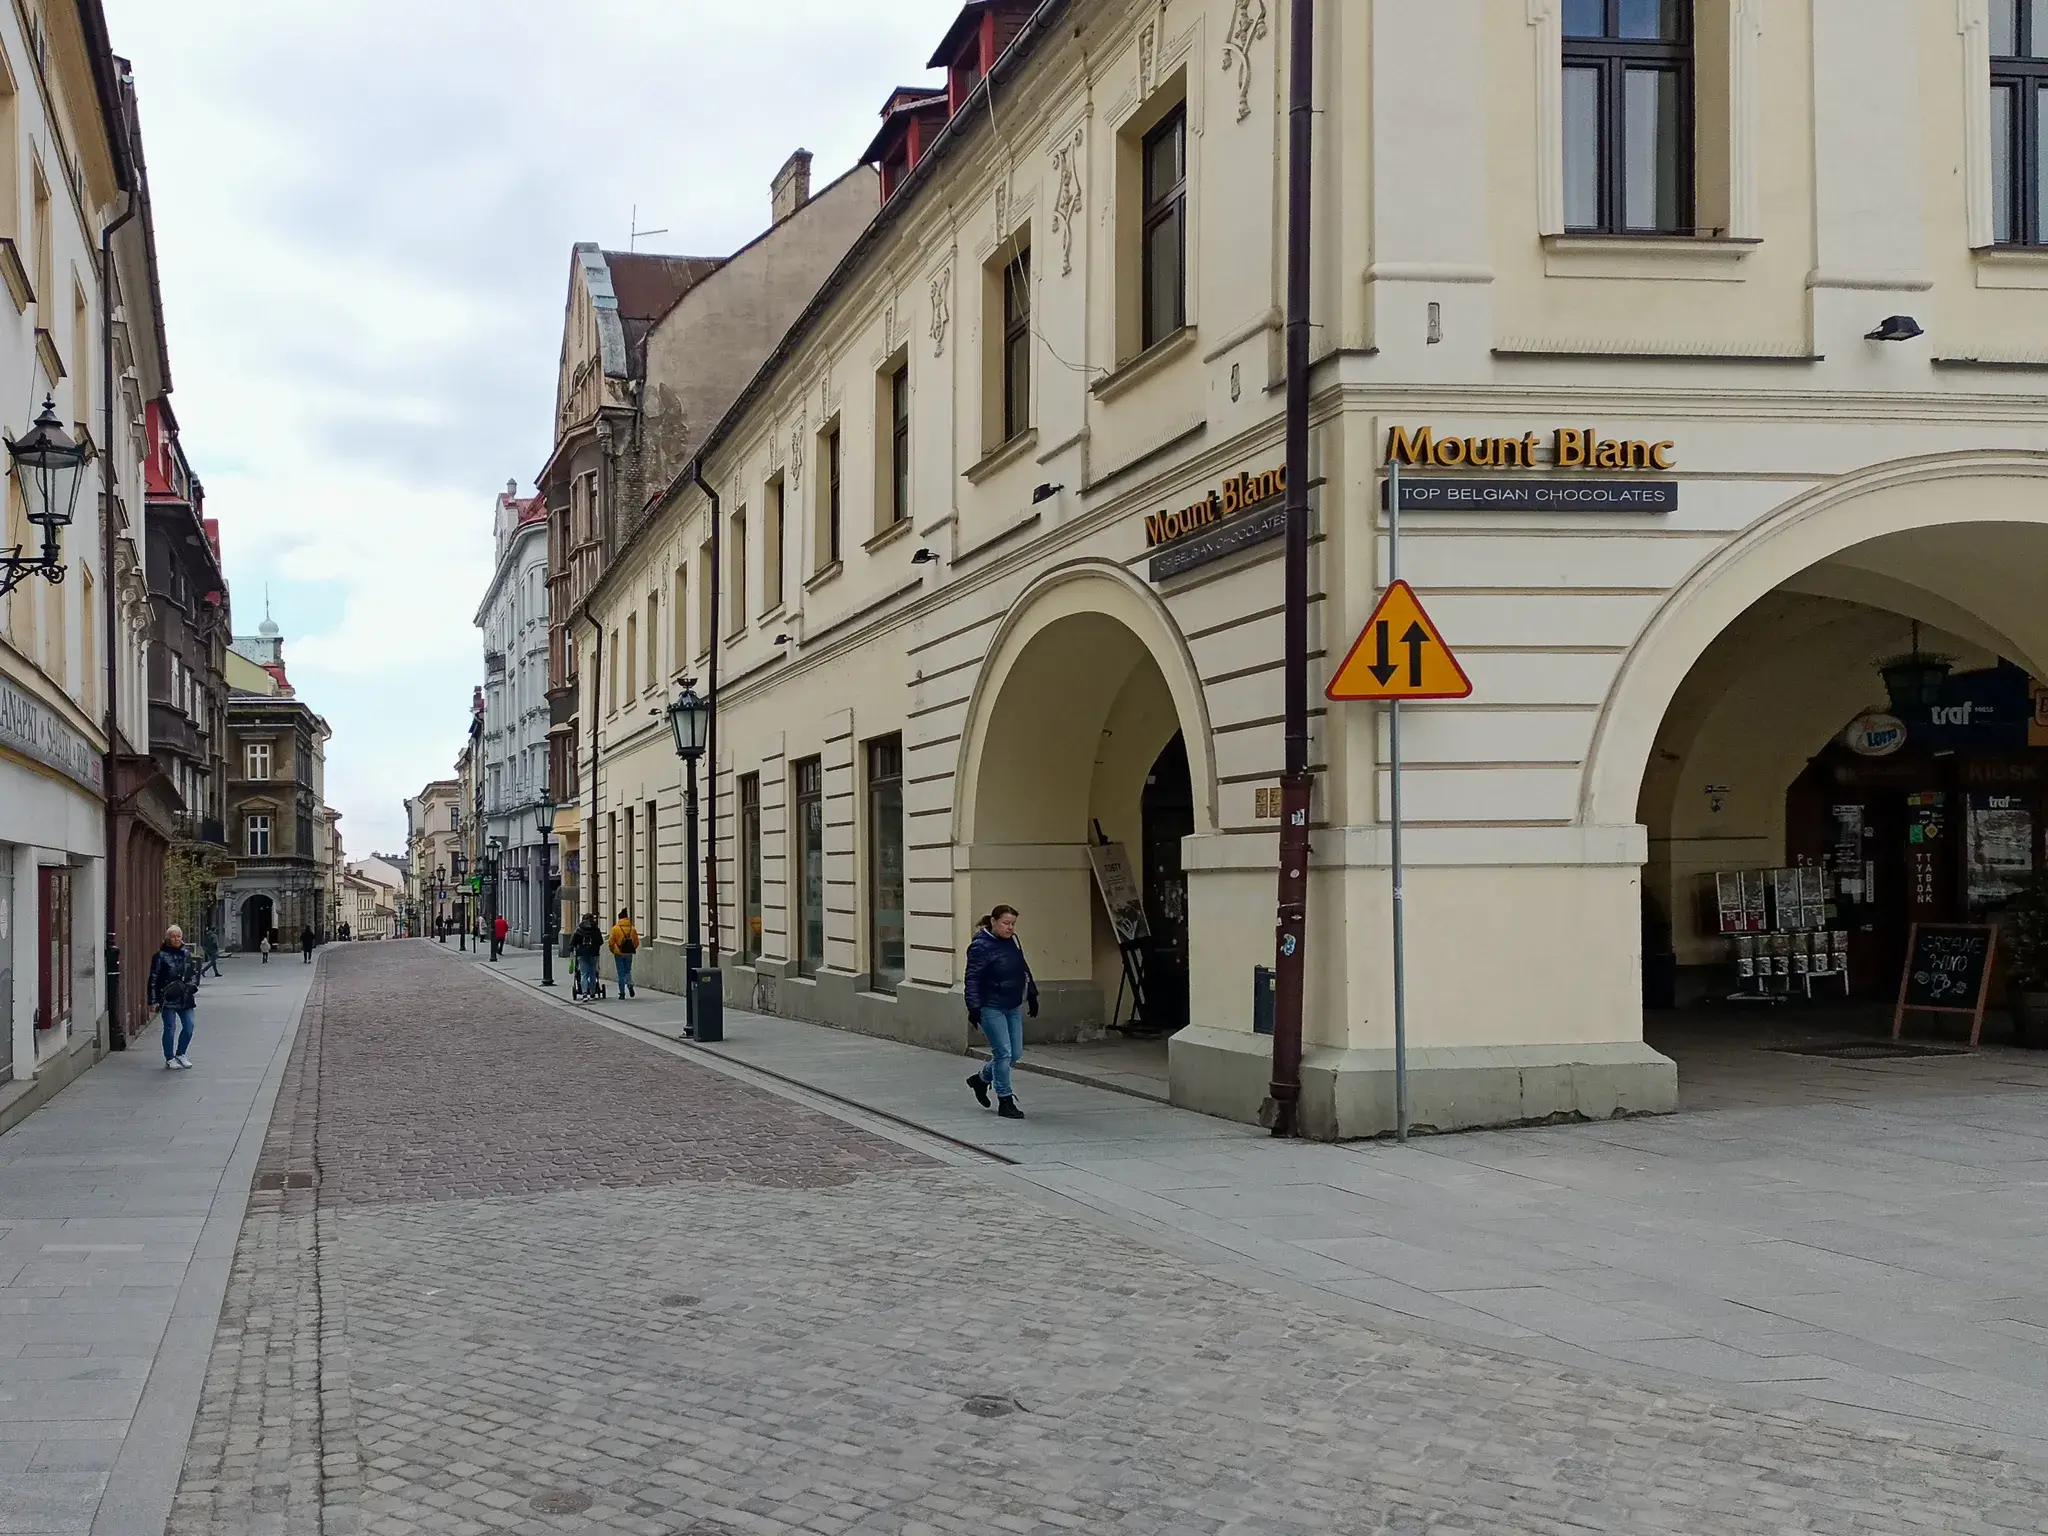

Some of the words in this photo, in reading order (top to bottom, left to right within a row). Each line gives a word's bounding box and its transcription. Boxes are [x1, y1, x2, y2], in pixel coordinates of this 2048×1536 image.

[1385, 425, 1541, 467] Mount
[1553, 427, 1677, 469] Blanc
[1402, 487, 1440, 500] TOP
[1448, 487, 1528, 500] BELGIAN
[1535, 488, 1666, 502] CHOCOLATES
[1145, 491, 1221, 548] Mount
[1930, 701, 1972, 725] traf
[1969, 763, 2038, 781] KIOSK
[1103, 862, 1122, 873] TOSTY
[1925, 853, 1934, 903] TABAK
